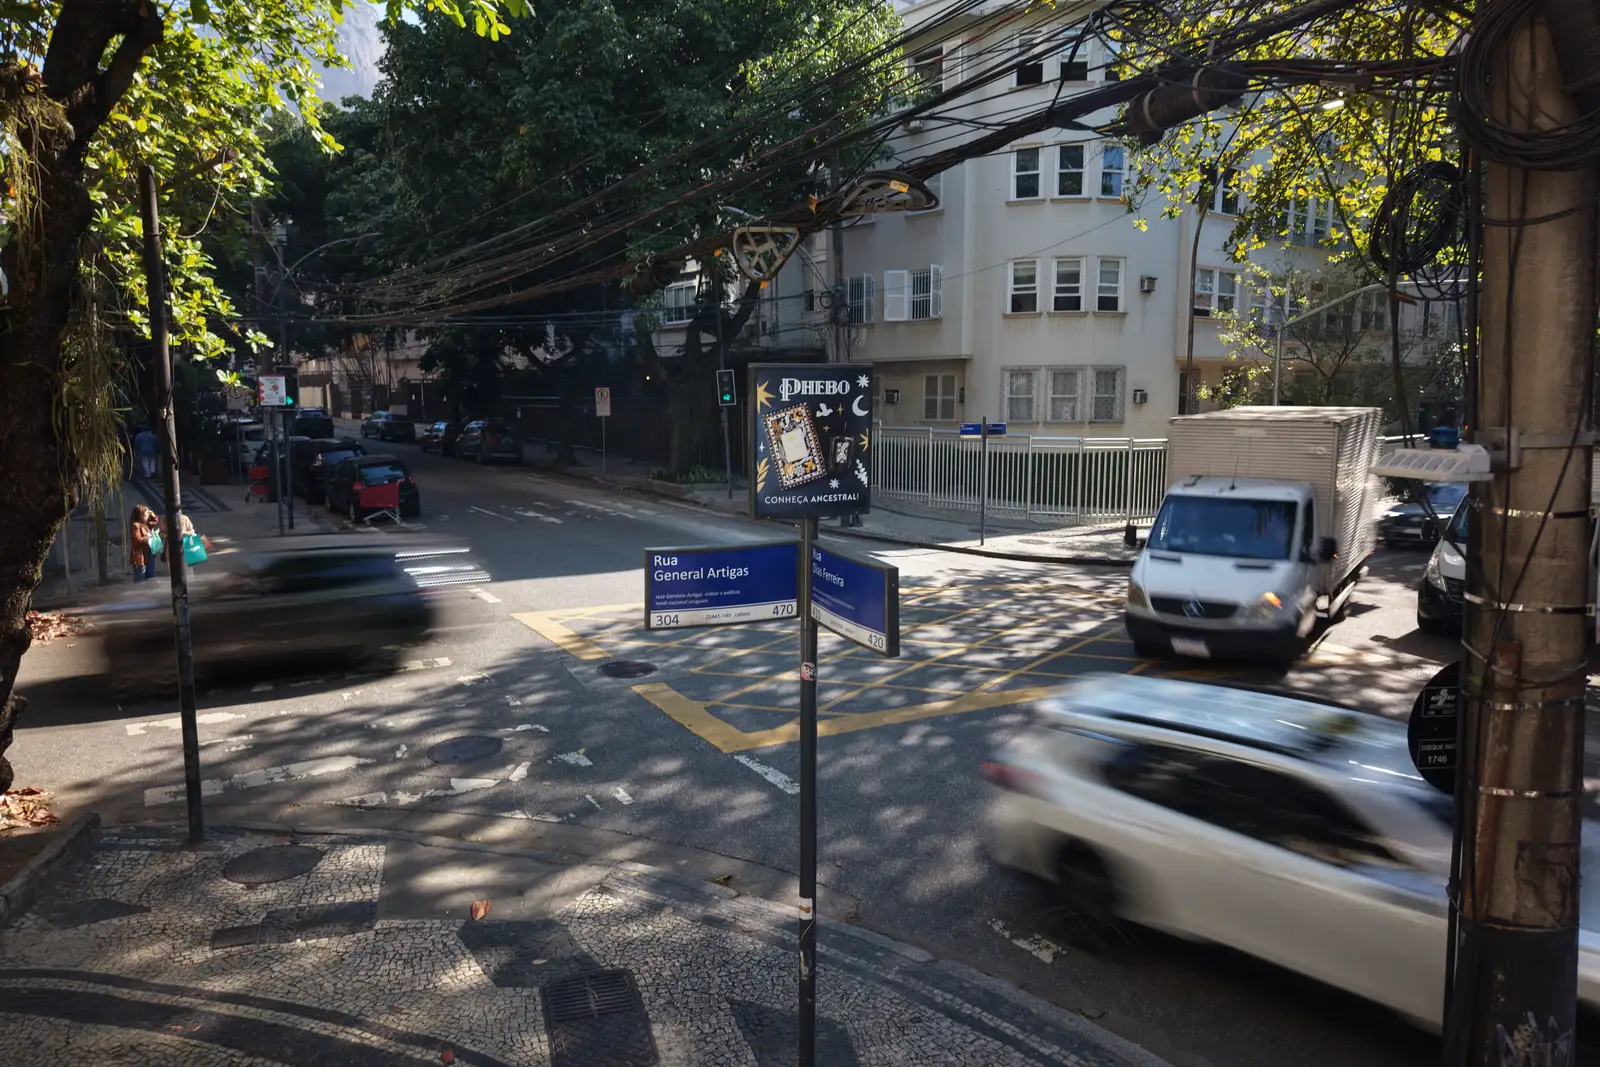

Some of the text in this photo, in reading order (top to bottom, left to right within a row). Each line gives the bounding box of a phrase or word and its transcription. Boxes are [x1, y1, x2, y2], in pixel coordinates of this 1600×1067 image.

[779, 378, 850, 401] PHEBO
[765, 493, 860, 505] CONHEÇA ANCESTRAL!
[654, 555, 678, 566] Rua
[812, 548, 822, 562] Rua
[654, 566, 749, 582] General Artigas
[812, 562, 844, 588] Dias Ferreira
[656, 614, 680, 627] 304
[772, 604, 793, 616] 470
[867, 633, 884, 649] 420
[1427, 755, 1448, 764] 1746
